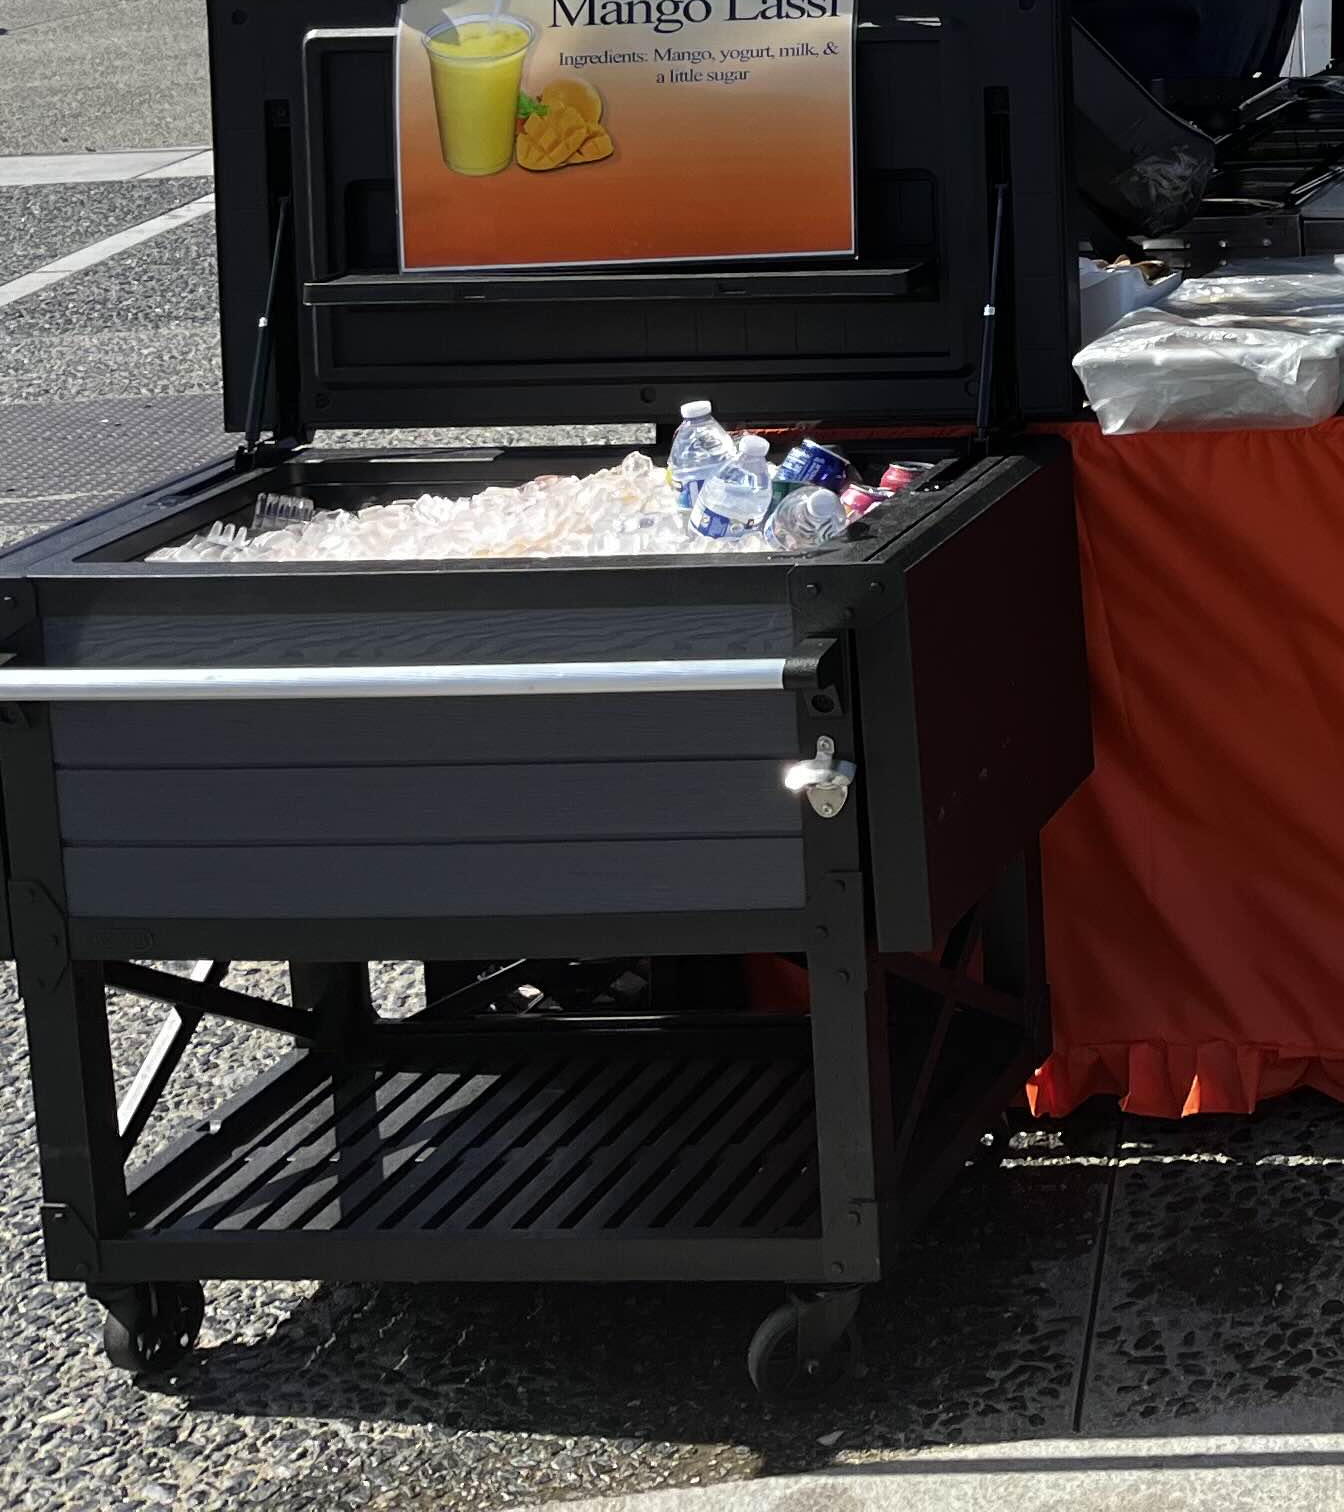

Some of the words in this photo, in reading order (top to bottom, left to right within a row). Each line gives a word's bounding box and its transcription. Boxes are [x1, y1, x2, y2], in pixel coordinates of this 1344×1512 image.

[558, 49, 648, 69] Ingredients:
[654, 48, 715, 64] Mango,
[719, 44, 775, 62] yogurt,
[779, 43, 819, 58] milk,
[822, 41, 840, 55] &
[656, 73, 665, 83] a
[670, 69, 703, 83] little
[707, 70, 750, 84] sugar
